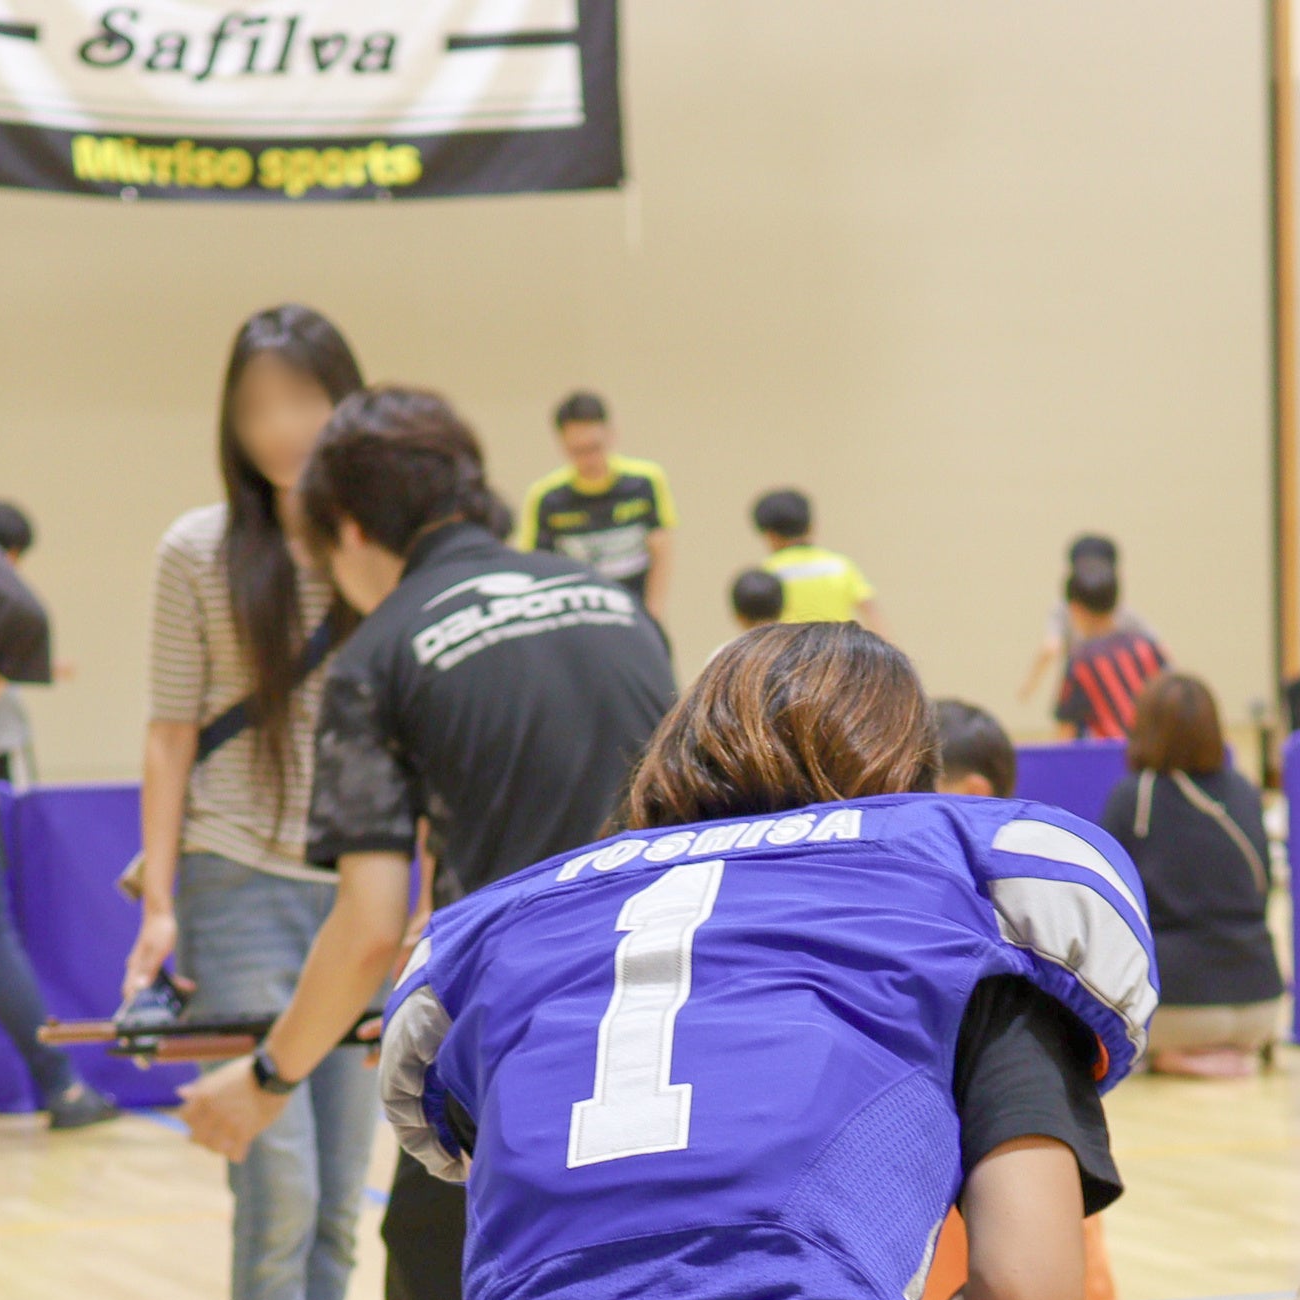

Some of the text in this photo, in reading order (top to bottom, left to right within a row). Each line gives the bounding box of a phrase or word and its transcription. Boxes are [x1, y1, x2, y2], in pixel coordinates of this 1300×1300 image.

[78, 6, 399, 83] Safilva
[257, 141, 423, 198] sports
[567, 859, 725, 1169] 1
